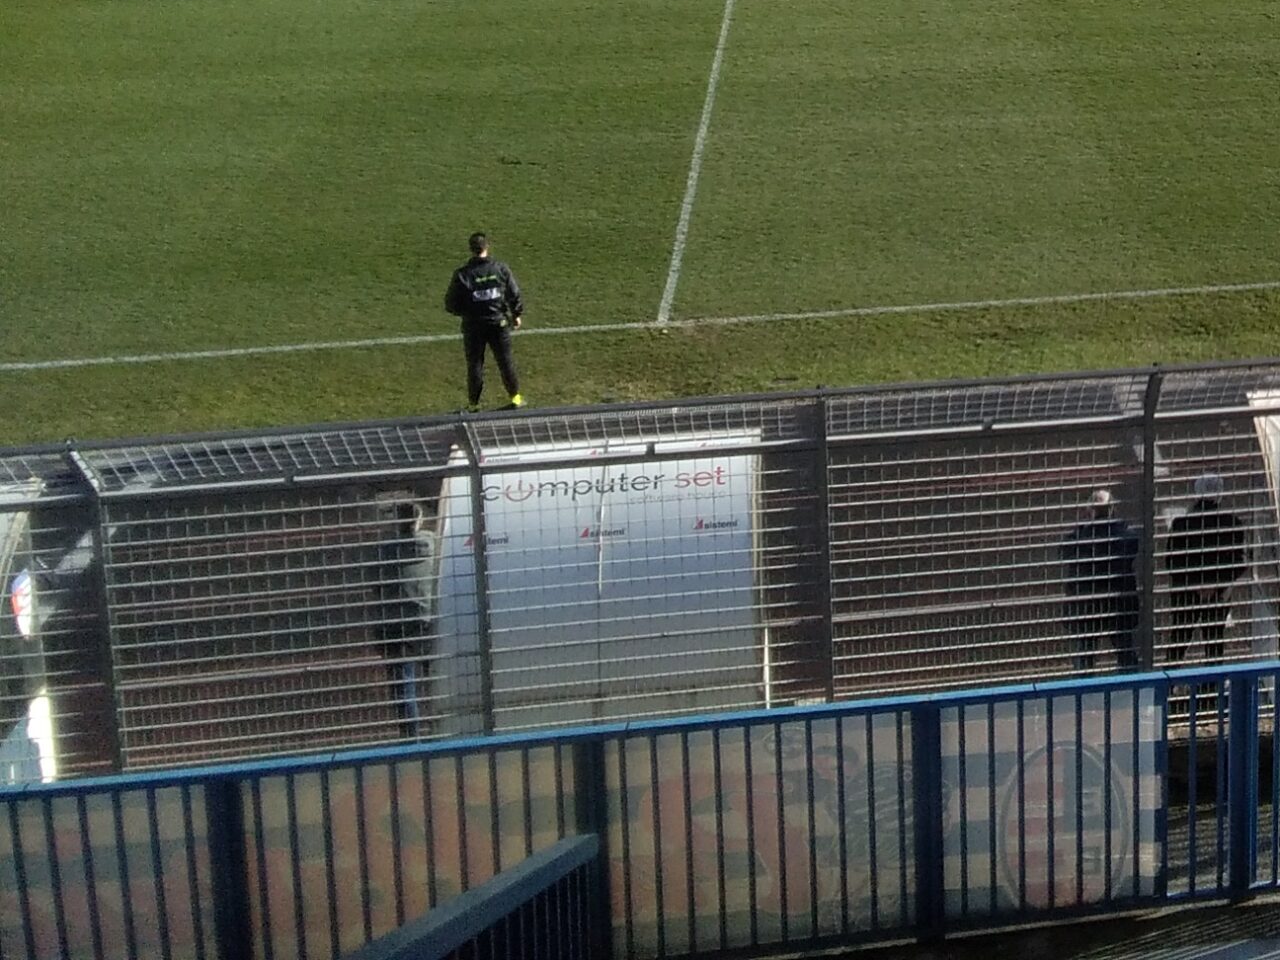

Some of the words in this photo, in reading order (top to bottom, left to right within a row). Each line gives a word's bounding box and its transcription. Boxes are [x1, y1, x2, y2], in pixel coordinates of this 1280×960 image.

[482, 471, 666, 502] computer
[673, 465, 727, 489] set
[703, 519, 739, 529] sistemi
